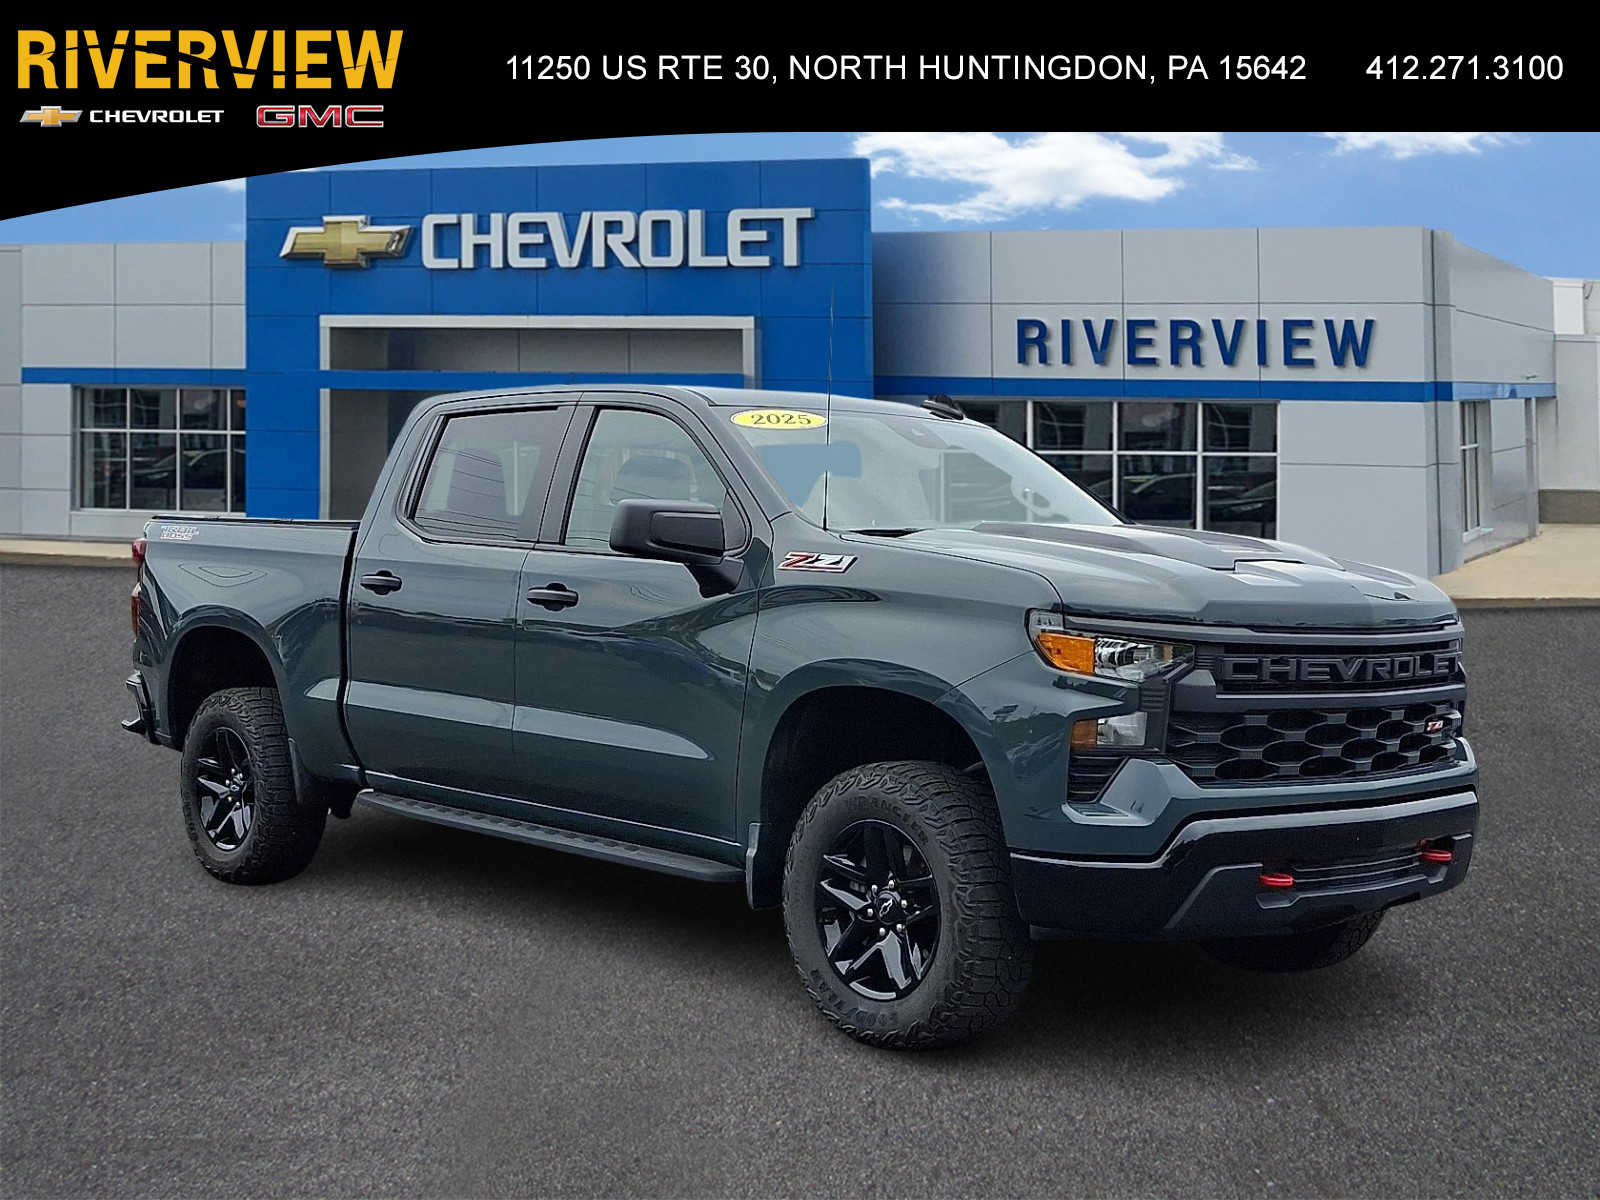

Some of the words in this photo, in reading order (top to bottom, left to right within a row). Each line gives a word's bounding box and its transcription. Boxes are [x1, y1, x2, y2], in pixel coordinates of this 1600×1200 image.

[422, 207, 812, 269] CHEVROLET
[1017, 318, 1376, 368] RIVERVIEW
[751, 413, 811, 425] 2025
[777, 551, 858, 573] Z71
